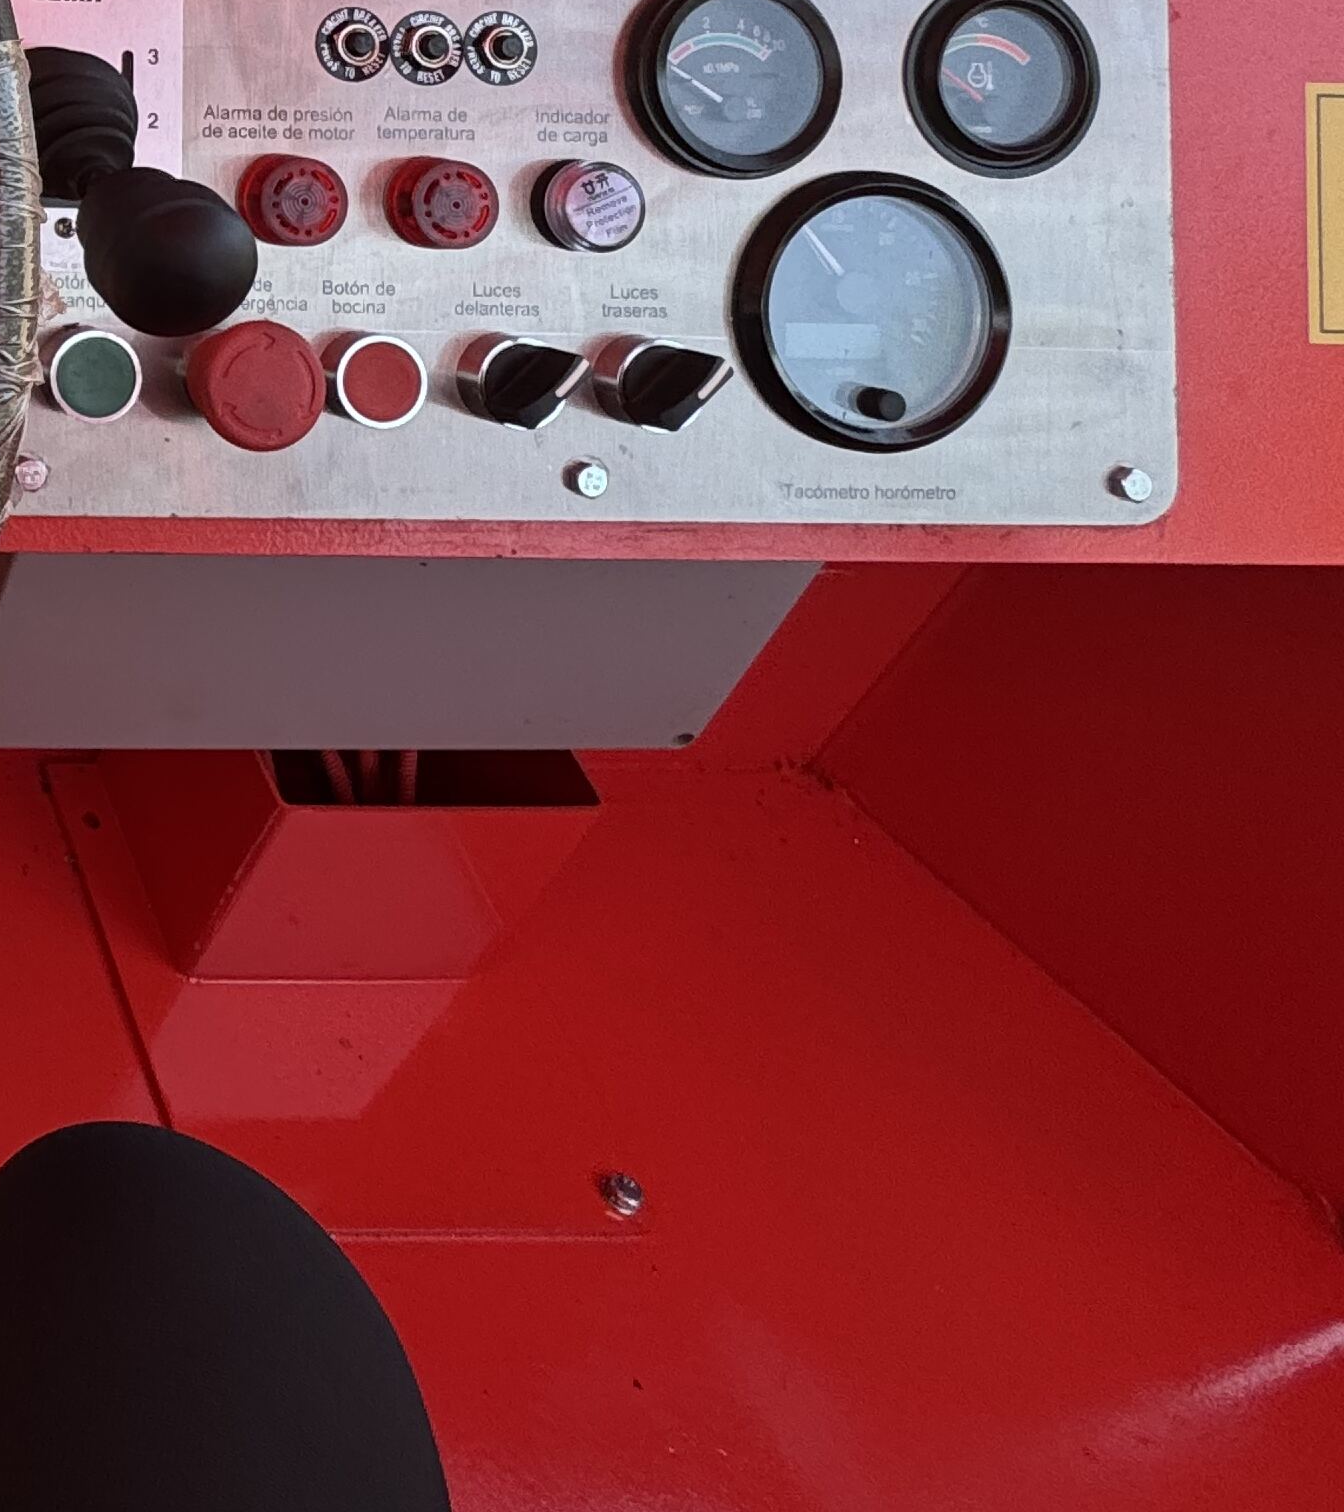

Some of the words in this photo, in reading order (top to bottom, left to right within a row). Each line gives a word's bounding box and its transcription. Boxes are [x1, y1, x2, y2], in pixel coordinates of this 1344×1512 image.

[702, 16, 710, 29] 2
[147, 48, 159, 65] 3
[147, 112, 159, 129] 2
[202, 104, 262, 120] Alarma
[267, 104, 288, 121] de
[293, 106, 353, 124] presión
[383, 106, 442, 122] Alarma
[447, 107, 467, 122] de
[535, 108, 610, 125] Indicador
[202, 124, 223, 138] de
[227, 124, 278, 139] aceite
[282, 124, 303, 139] de
[308, 126, 355, 141] motor
[376, 125, 475, 142] temperatura
[537, 127, 557, 142] de
[562, 130, 608, 147] carga
[585, 195, 628, 217] Remove
[586, 205, 636, 228] Protection
[55, 273, 90, 290] otón
[322, 279, 369, 295] Botón
[375, 281, 396, 296] de
[472, 282, 521, 297] Luces
[610, 283, 659, 300] Luces
[332, 299, 386, 314] bocina
[454, 300, 540, 317] delanteras
[601, 303, 668, 318] traseras
[783, 482, 870, 500] Tacómetro
[874, 484, 956, 501] horómetro
